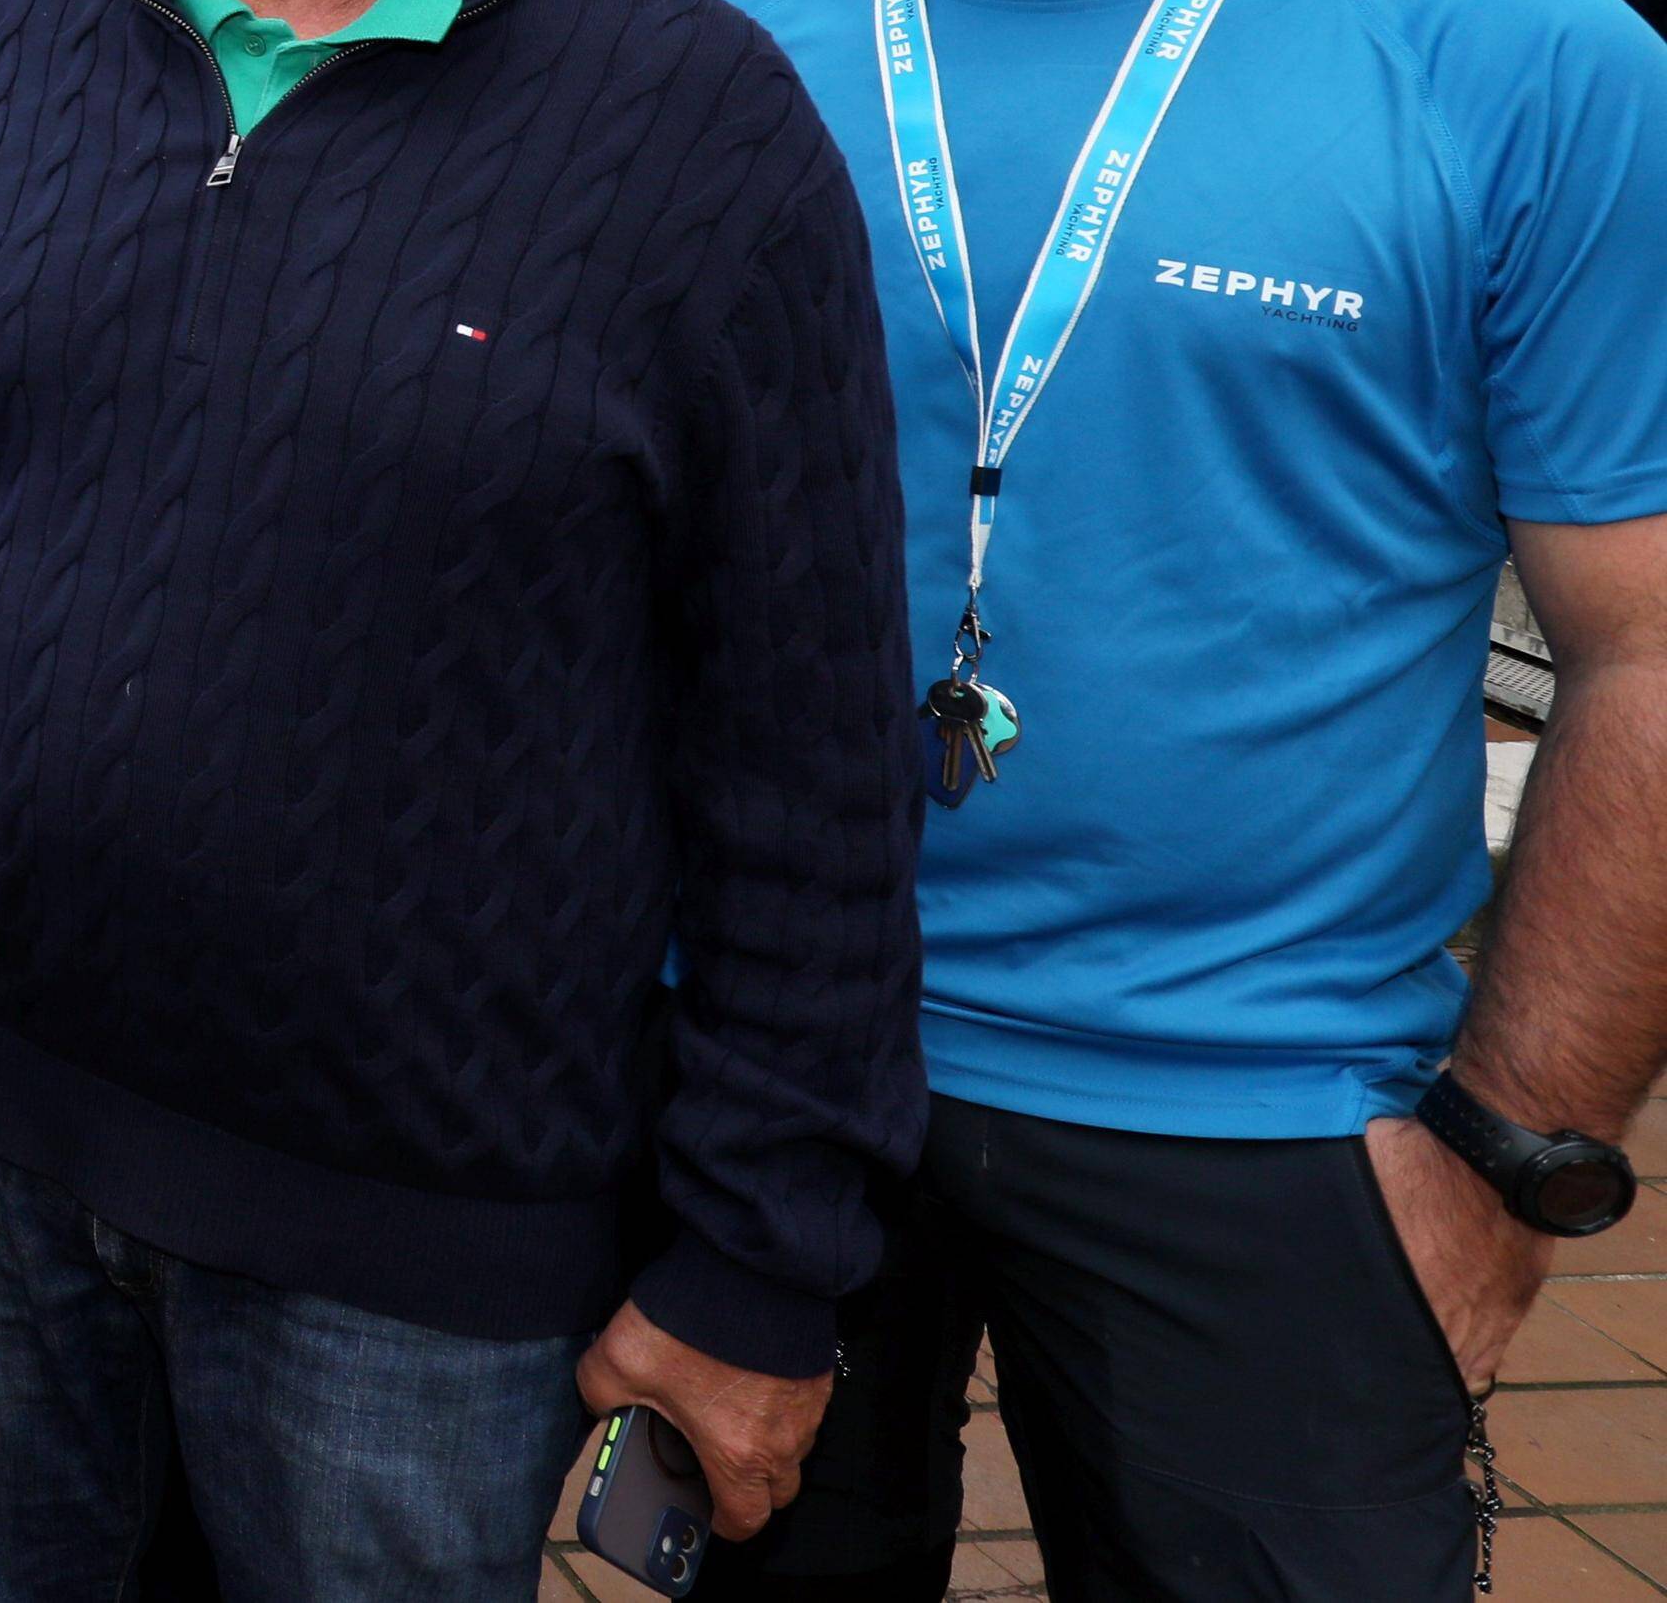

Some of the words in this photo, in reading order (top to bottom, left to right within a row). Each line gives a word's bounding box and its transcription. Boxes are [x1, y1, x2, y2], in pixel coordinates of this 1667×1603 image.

[1144, 5, 1178, 56] YACHTING
[929, 157, 945, 210] YACHTING
[1066, 149, 1132, 262] ZEPHYR
[907, 159, 947, 271] ZEPHYR
[1055, 203, 1085, 257] YACHTING
[1154, 258, 1365, 320] ZEPHYR
[1260, 304, 1359, 333] YACHTING
[987, 354, 1044, 465] ZEPHYR
